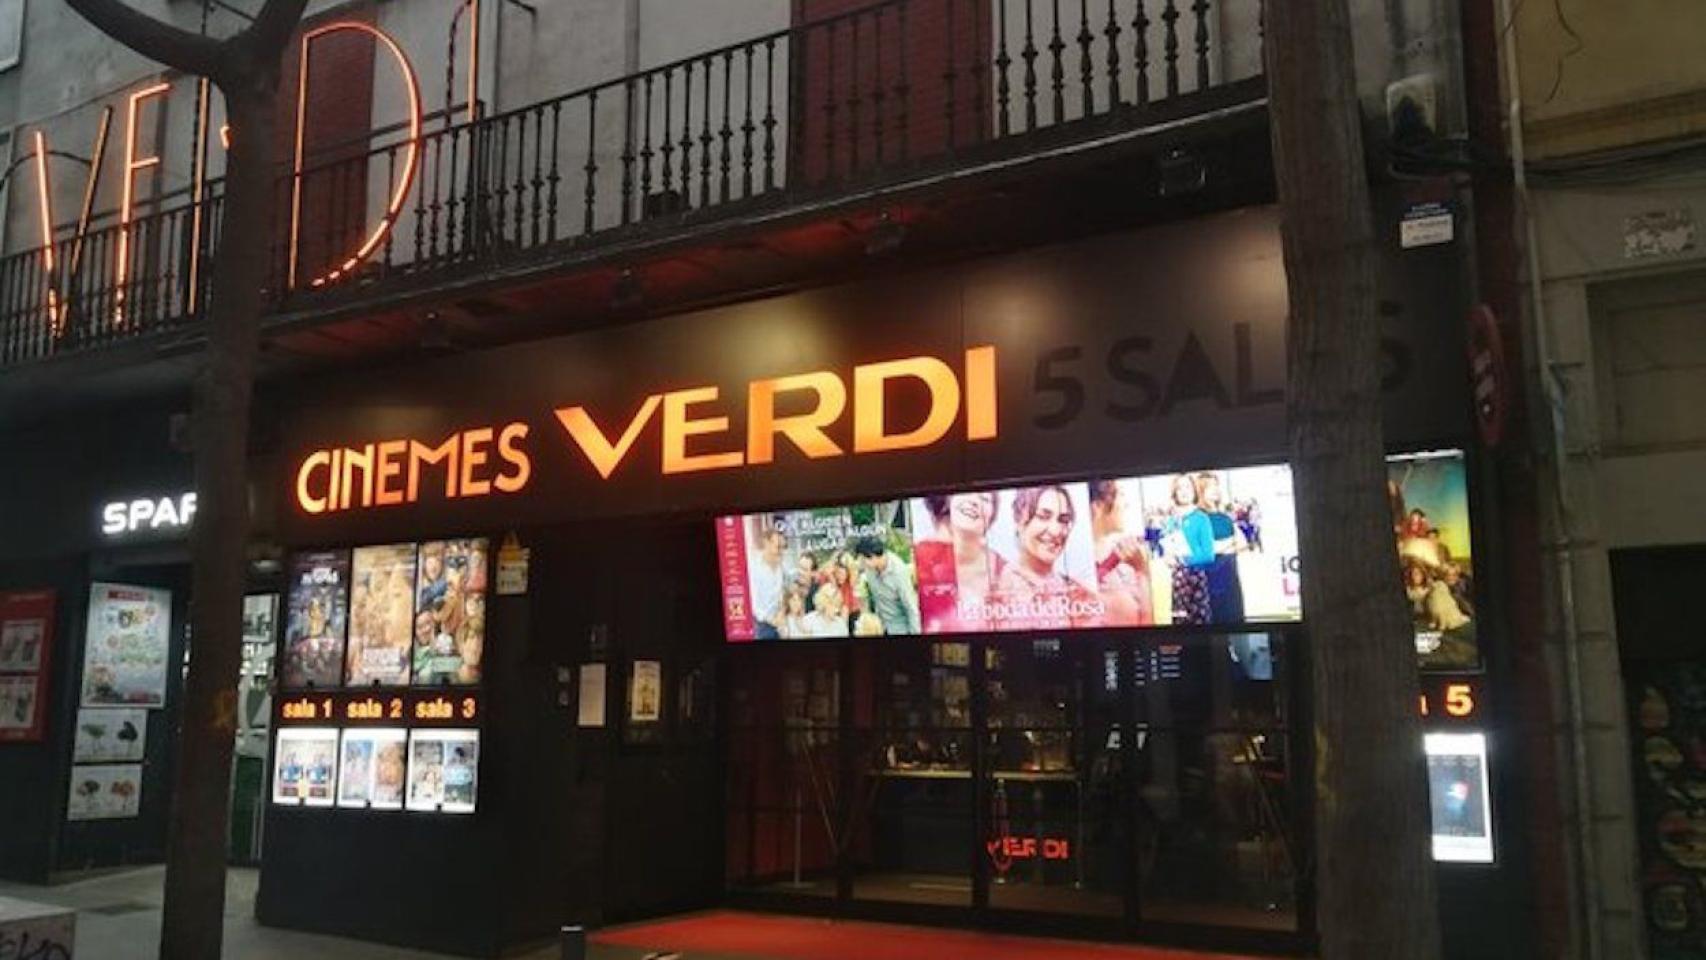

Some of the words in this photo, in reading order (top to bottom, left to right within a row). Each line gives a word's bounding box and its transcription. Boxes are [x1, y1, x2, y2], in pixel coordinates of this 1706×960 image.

[35, 0, 481, 338] VEDI
[296, 422, 532, 514] CINEMES
[554, 344, 998, 480] VERDI
[1032, 346, 1086, 431] 5
[1059, 596, 1105, 618] Rosa
[282, 698, 317, 719] sala
[323, 698, 333, 718] 1
[347, 698, 383, 719] sala
[389, 698, 402, 718] 2
[415, 697, 453, 719] sala
[462, 698, 476, 719] 3
[1446, 684, 1474, 716] 5
